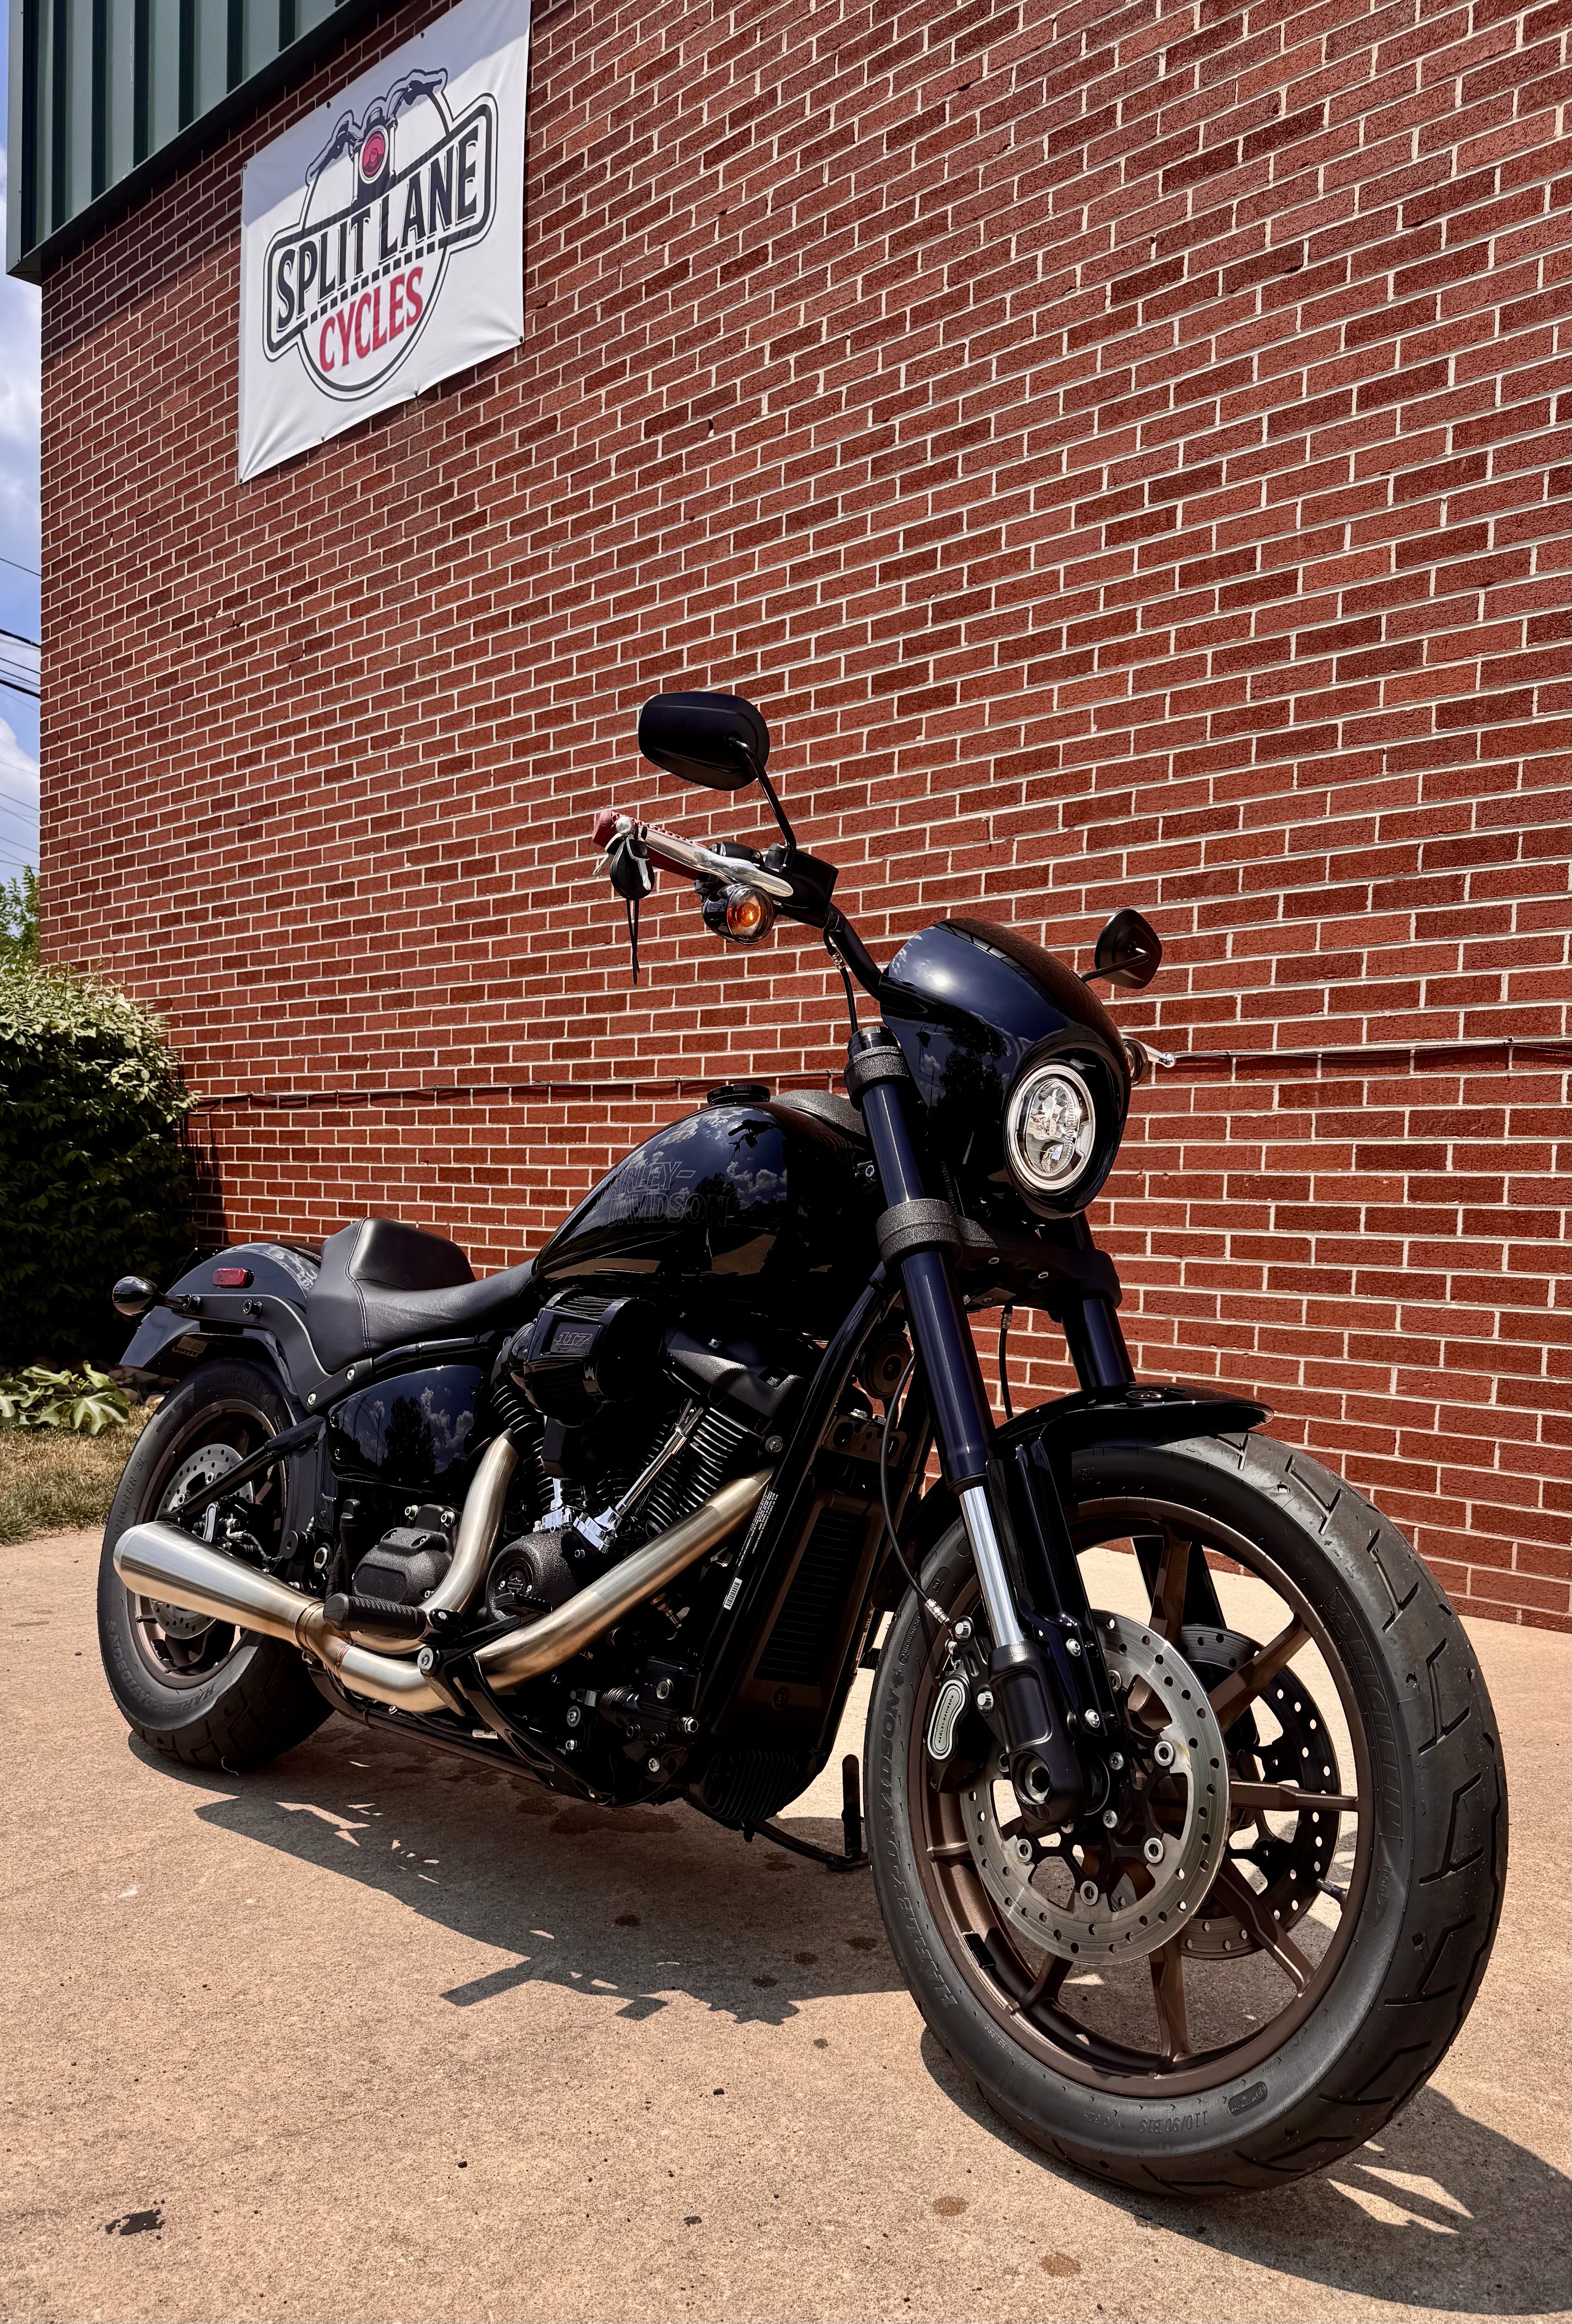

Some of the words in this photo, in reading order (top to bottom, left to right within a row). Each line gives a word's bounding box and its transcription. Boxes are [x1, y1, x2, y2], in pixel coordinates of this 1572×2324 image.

[277, 208, 371, 332] SPLIT
[378, 125, 478, 259] LANE
[319, 266, 423, 373] CYCLES
[608, 1193, 729, 1227] DAVIDSON
[557, 1332, 593, 1346] 117
[938, 1695, 954, 1744] HARLEY-DAVIDSON
[1345, 1638, 1401, 1834] MICHELIN
[1165, 2111, 1208, 2133] 110/90
